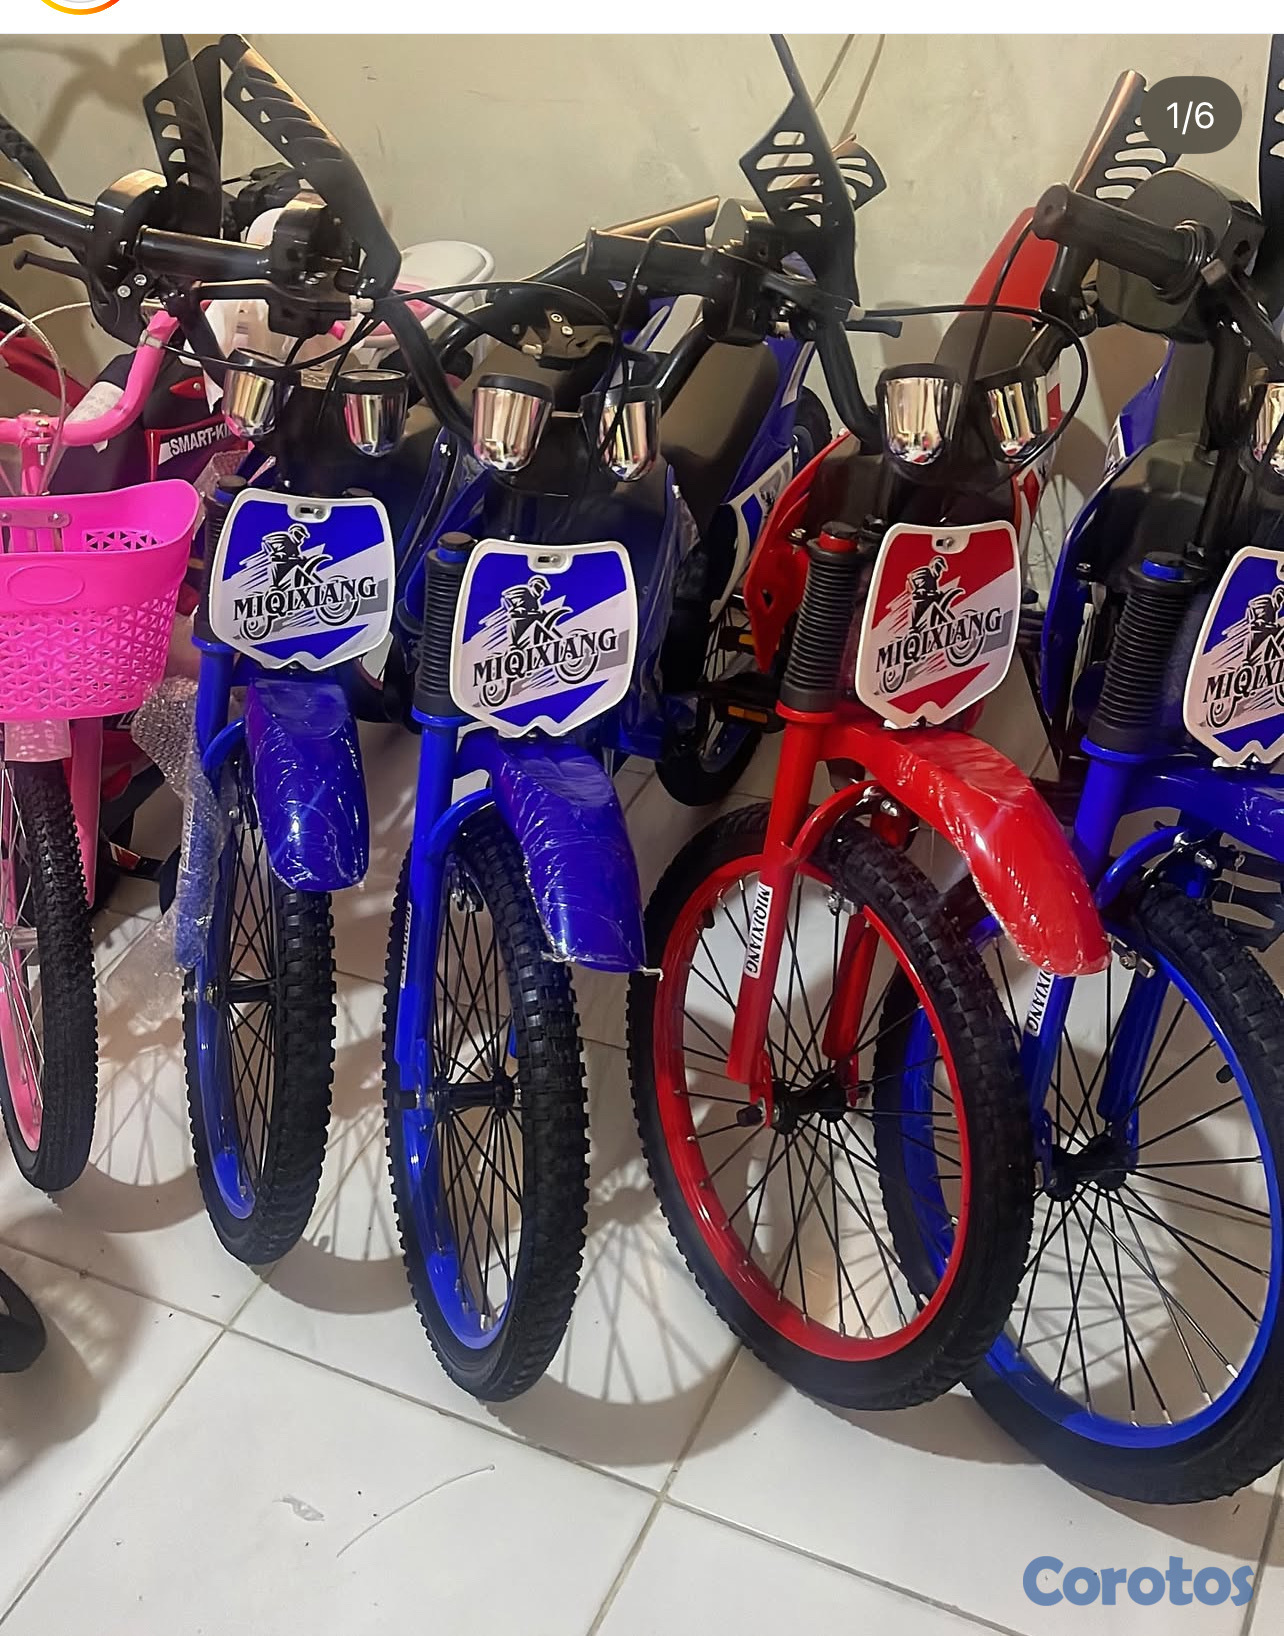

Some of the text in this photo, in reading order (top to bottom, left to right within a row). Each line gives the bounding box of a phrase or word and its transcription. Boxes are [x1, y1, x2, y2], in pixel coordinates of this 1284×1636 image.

[170, 423, 231, 455] SMART-KI
[233, 576, 377, 621] MIQIXIANG
[473, 628, 617, 686] MIQIXIANG
[876, 608, 1002, 673] MIQIXIANG
[746, 885, 770, 974] MIQIXIANG
[1027, 969, 1053, 1032] IXIANG
